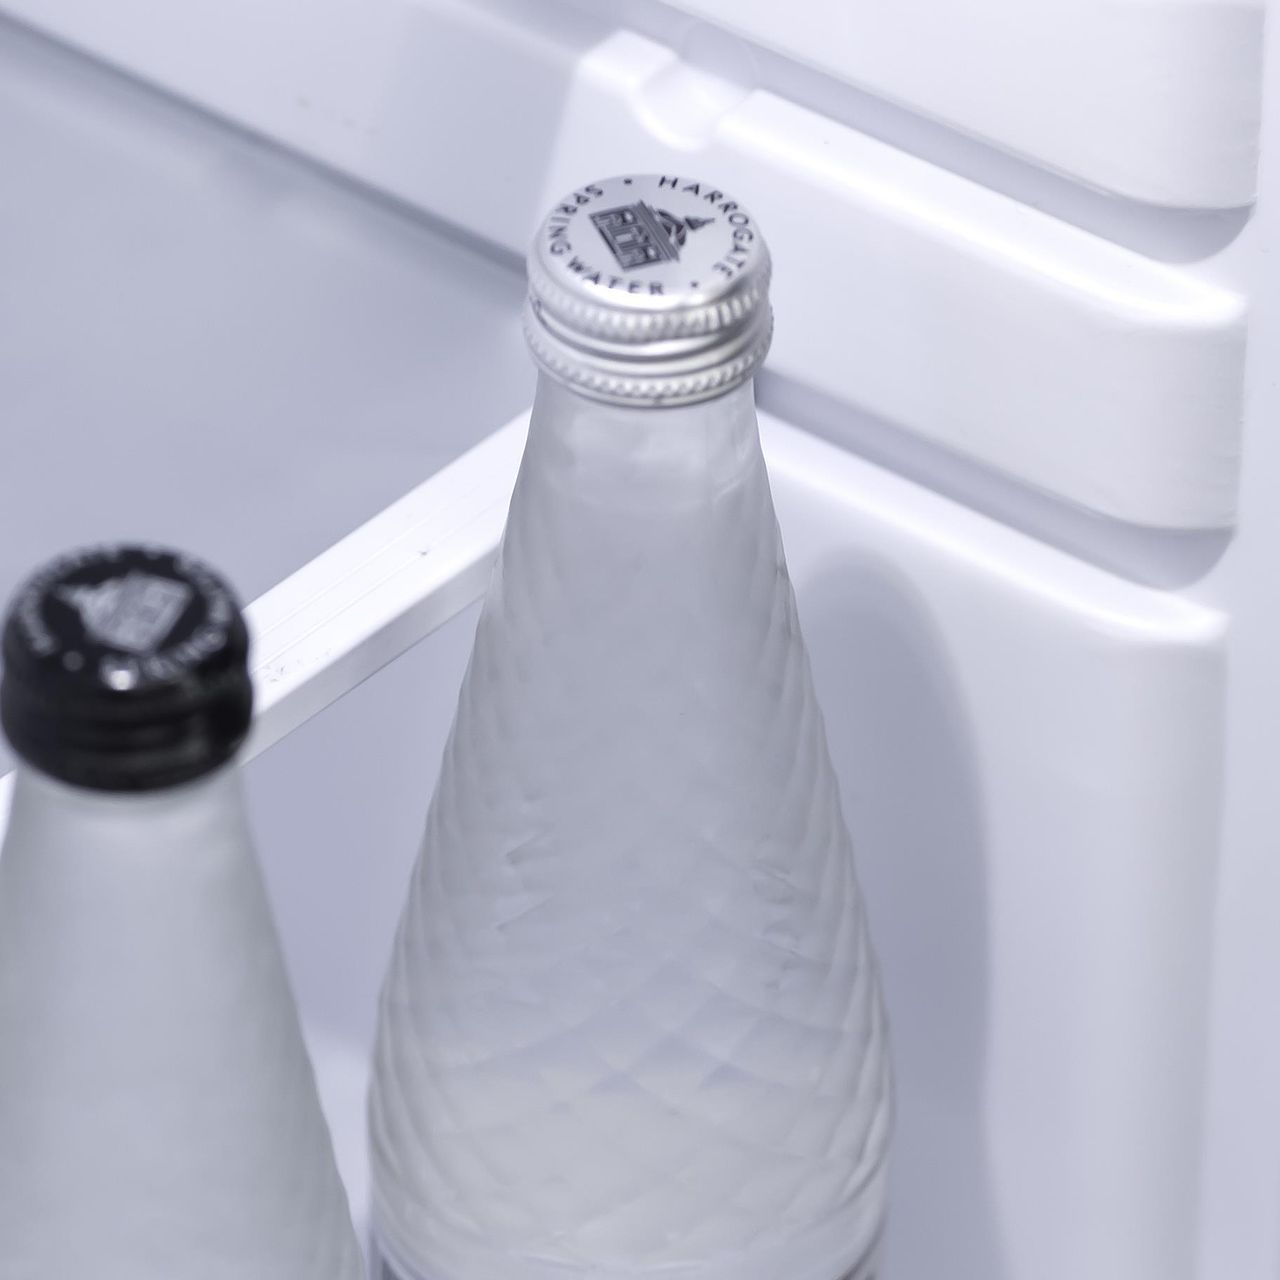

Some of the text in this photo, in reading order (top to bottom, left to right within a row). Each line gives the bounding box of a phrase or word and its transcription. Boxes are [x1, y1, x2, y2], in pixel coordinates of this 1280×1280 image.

[549, 184, 665, 295] SPRING WATER
[658, 175, 754, 279] HARROGATE
